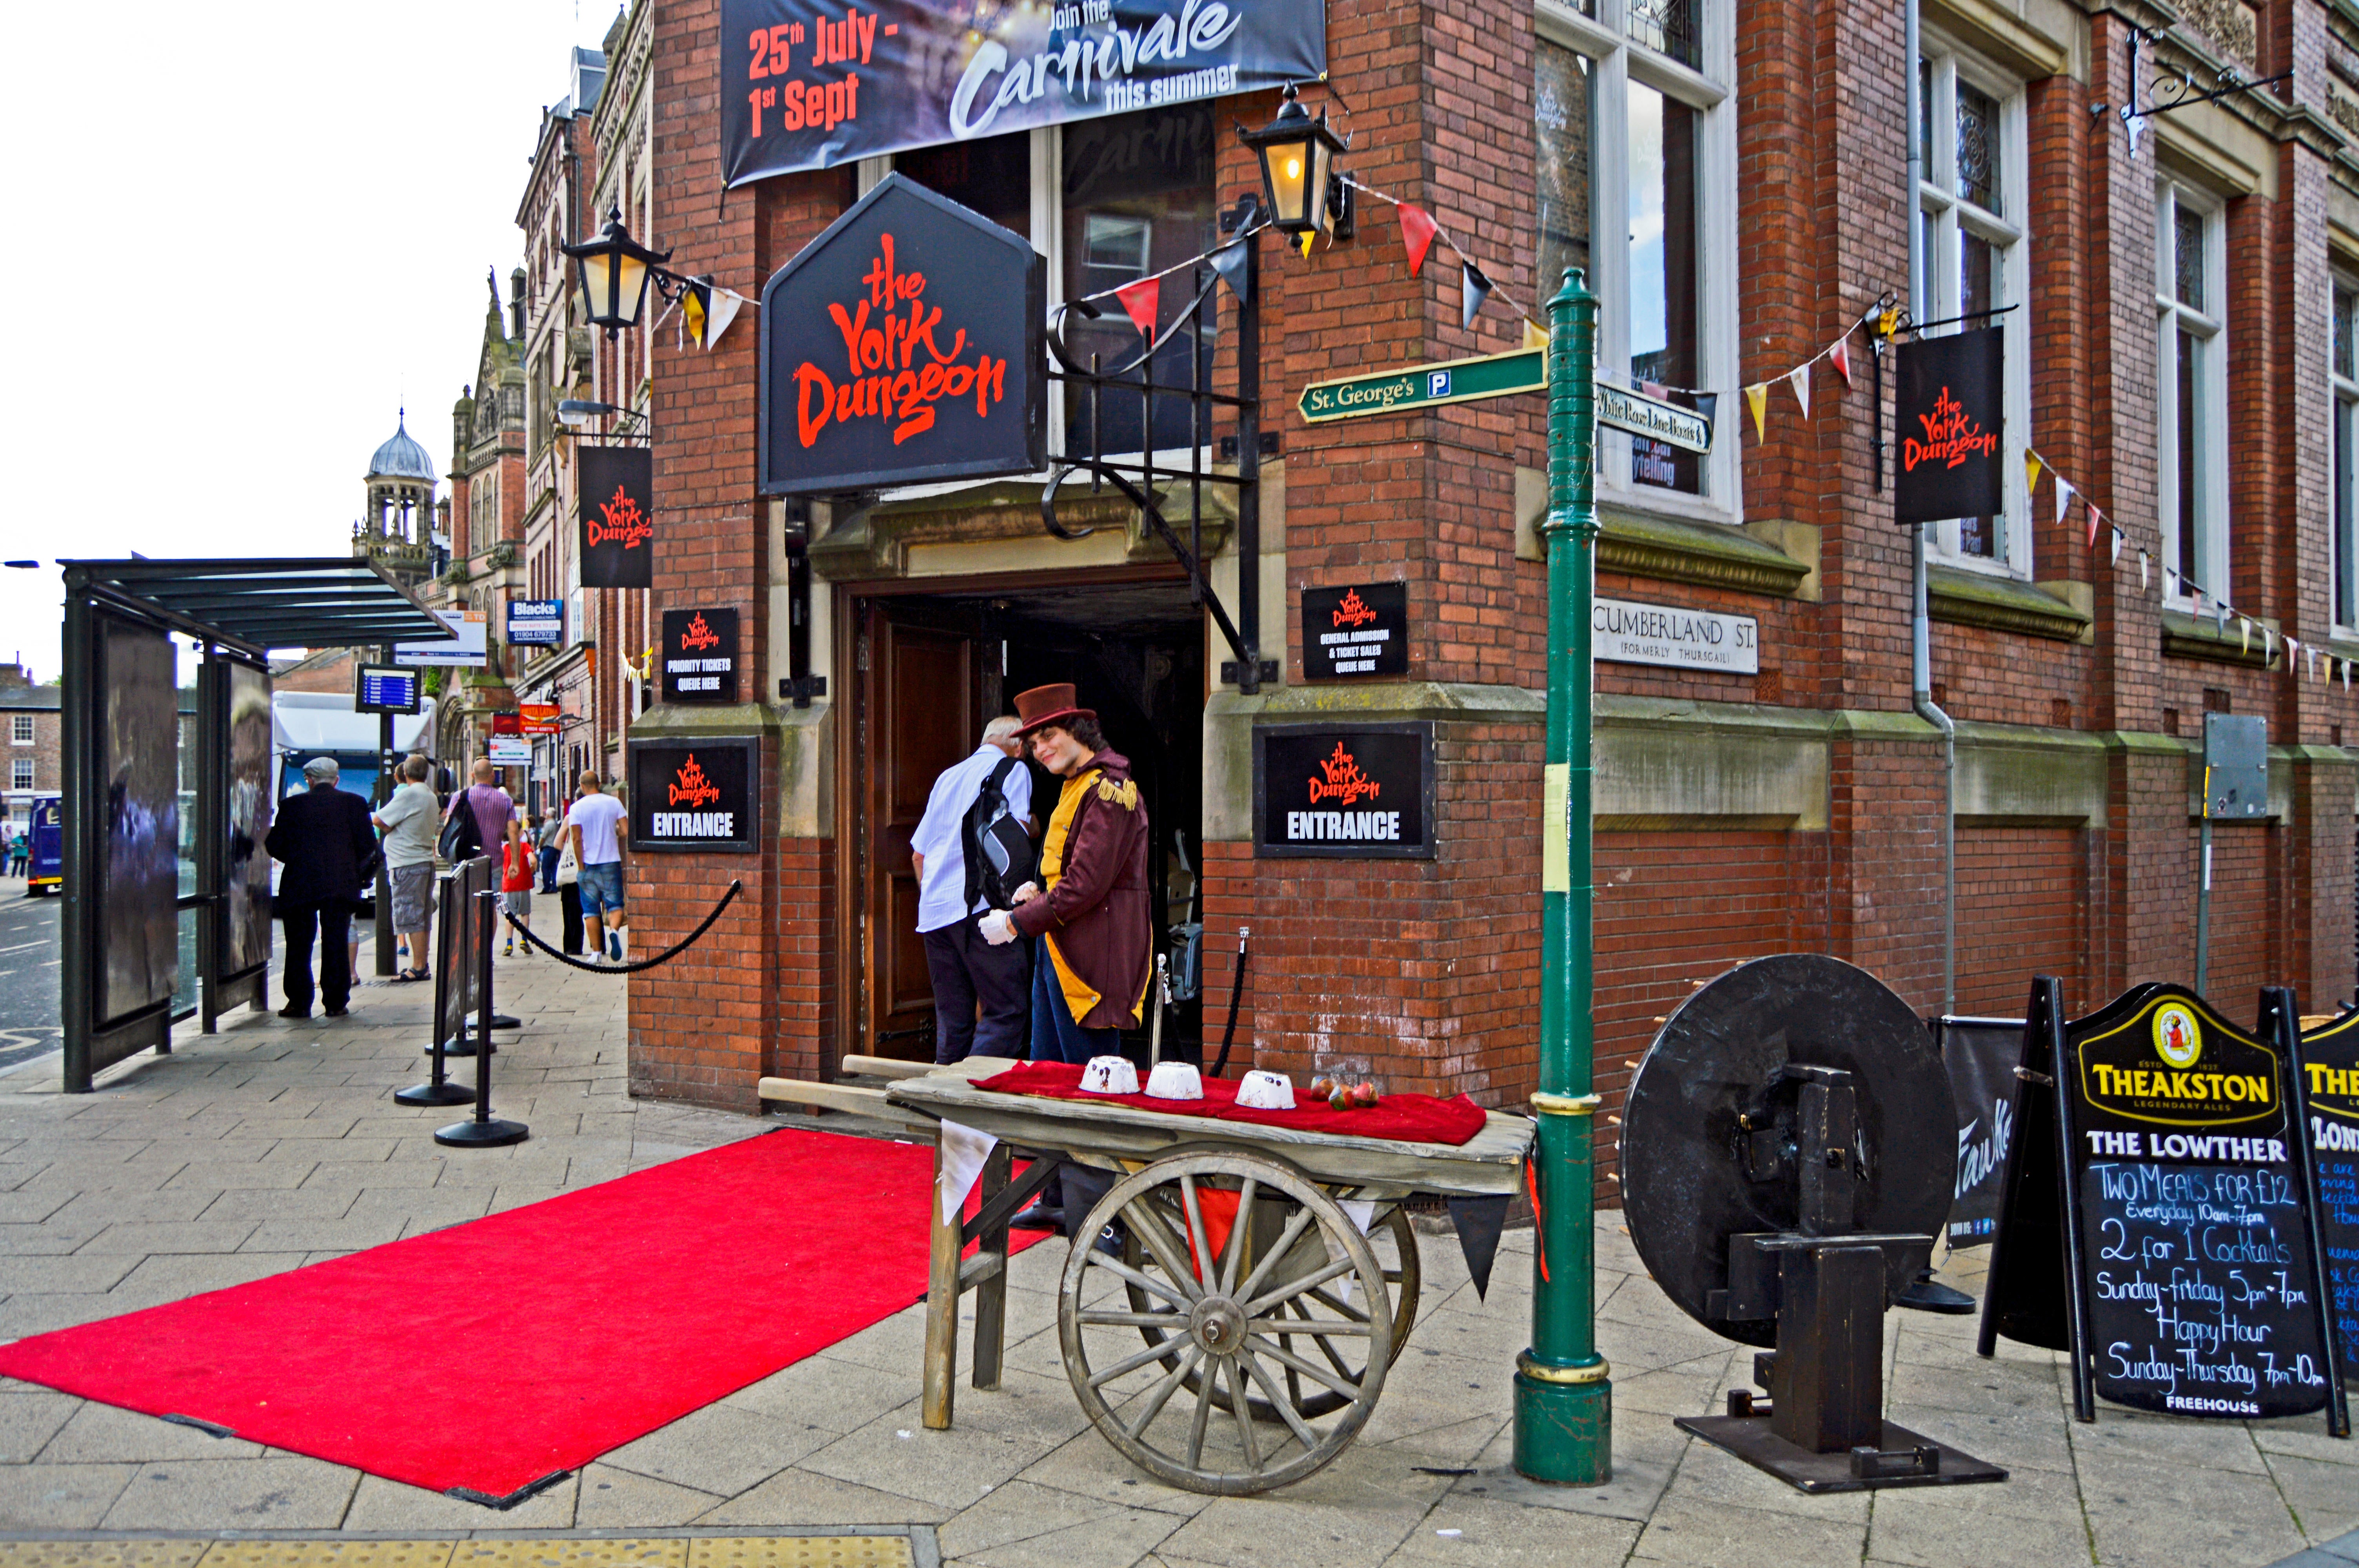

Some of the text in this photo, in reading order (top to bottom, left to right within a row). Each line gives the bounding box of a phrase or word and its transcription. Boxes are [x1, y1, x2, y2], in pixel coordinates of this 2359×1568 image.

[1048, 0, 1109, 32] Join the
[749, 22, 804, 80] 25th
[812, 8, 878, 67] July
[949, 0, 1242, 140] Carnivale
[1105, 63, 1239, 112] this summer
[749, 73, 859, 138] 1st Sept
[863, 233, 926, 311] the
[828, 299, 966, 376] York
[793, 355, 1006, 448] Dungeon
[1311, 391, 1334, 411] St.
[1338, 377, 1414, 407] George's
[1934, 386, 1962, 417] the
[1625, 400, 1647, 424] Rose
[1919, 413, 1979, 443] York
[1903, 433, 1997, 472] Dungeon
[1633, 454, 1675, 487] ytelling
[612, 485, 636, 508] the
[599, 503, 650, 528] York
[587, 520, 652, 549] Dungeo
[1339, 599, 1368, 614] York
[1347, 588, 1359, 602] the
[514, 602, 556, 615] Blacks
[694, 611, 705, 626] the
[1333, 610, 1376, 627] Dungeon
[688, 622, 712, 638] York
[1320, 629, 1389, 645] GENERAL ADMISSION
[1594, 606, 1754, 648] CUMBERLAND ST.
[682, 633, 719, 651] Dungeon
[1329, 644, 1381, 659] & TICKET SALES
[1621, 641, 1670, 658] (FORMERLY
[667, 658, 731, 673] PRIORITY TICKETS
[1336, 659, 1376, 674] QUEUE HERE
[678, 677, 720, 692] QUEUE HERE
[685, 753, 700, 773] the
[1332, 741, 1353, 765] the
[677, 769, 710, 789] York
[1320, 760, 1367, 784] York
[669, 783, 719, 808] Dungeon
[1309, 776, 1380, 806] Dungeon
[653, 813, 733, 837] ENTRANCE
[1288, 811, 1399, 840] ENTRANCE
[2092, 1064, 2269, 1102] THEAKSTON
[2304, 1063, 2359, 1096] THE
[2134, 1100, 2231, 1111] LEGENDARY ALES
[1955, 1098, 2013, 1200] Fawke
[2086, 1131, 2286, 1162] THE LOWTHER
[2089, 1163, 2138, 1201] TWO
[2139, 1163, 2210, 1202] MEALS
[2255, 1169, 2296, 1205] £12
[2125, 1202, 2195, 1227] Everyday
[1950, 1221, 1961, 1236] JOIN
[1963, 1221, 1972, 1234] US:
[2101, 1218, 2292, 1270] 2 for 1 Cocktails
[2157, 1305, 2271, 1354] Happy Hour
[2167, 1396, 2259, 1413] FREEHOUSE
